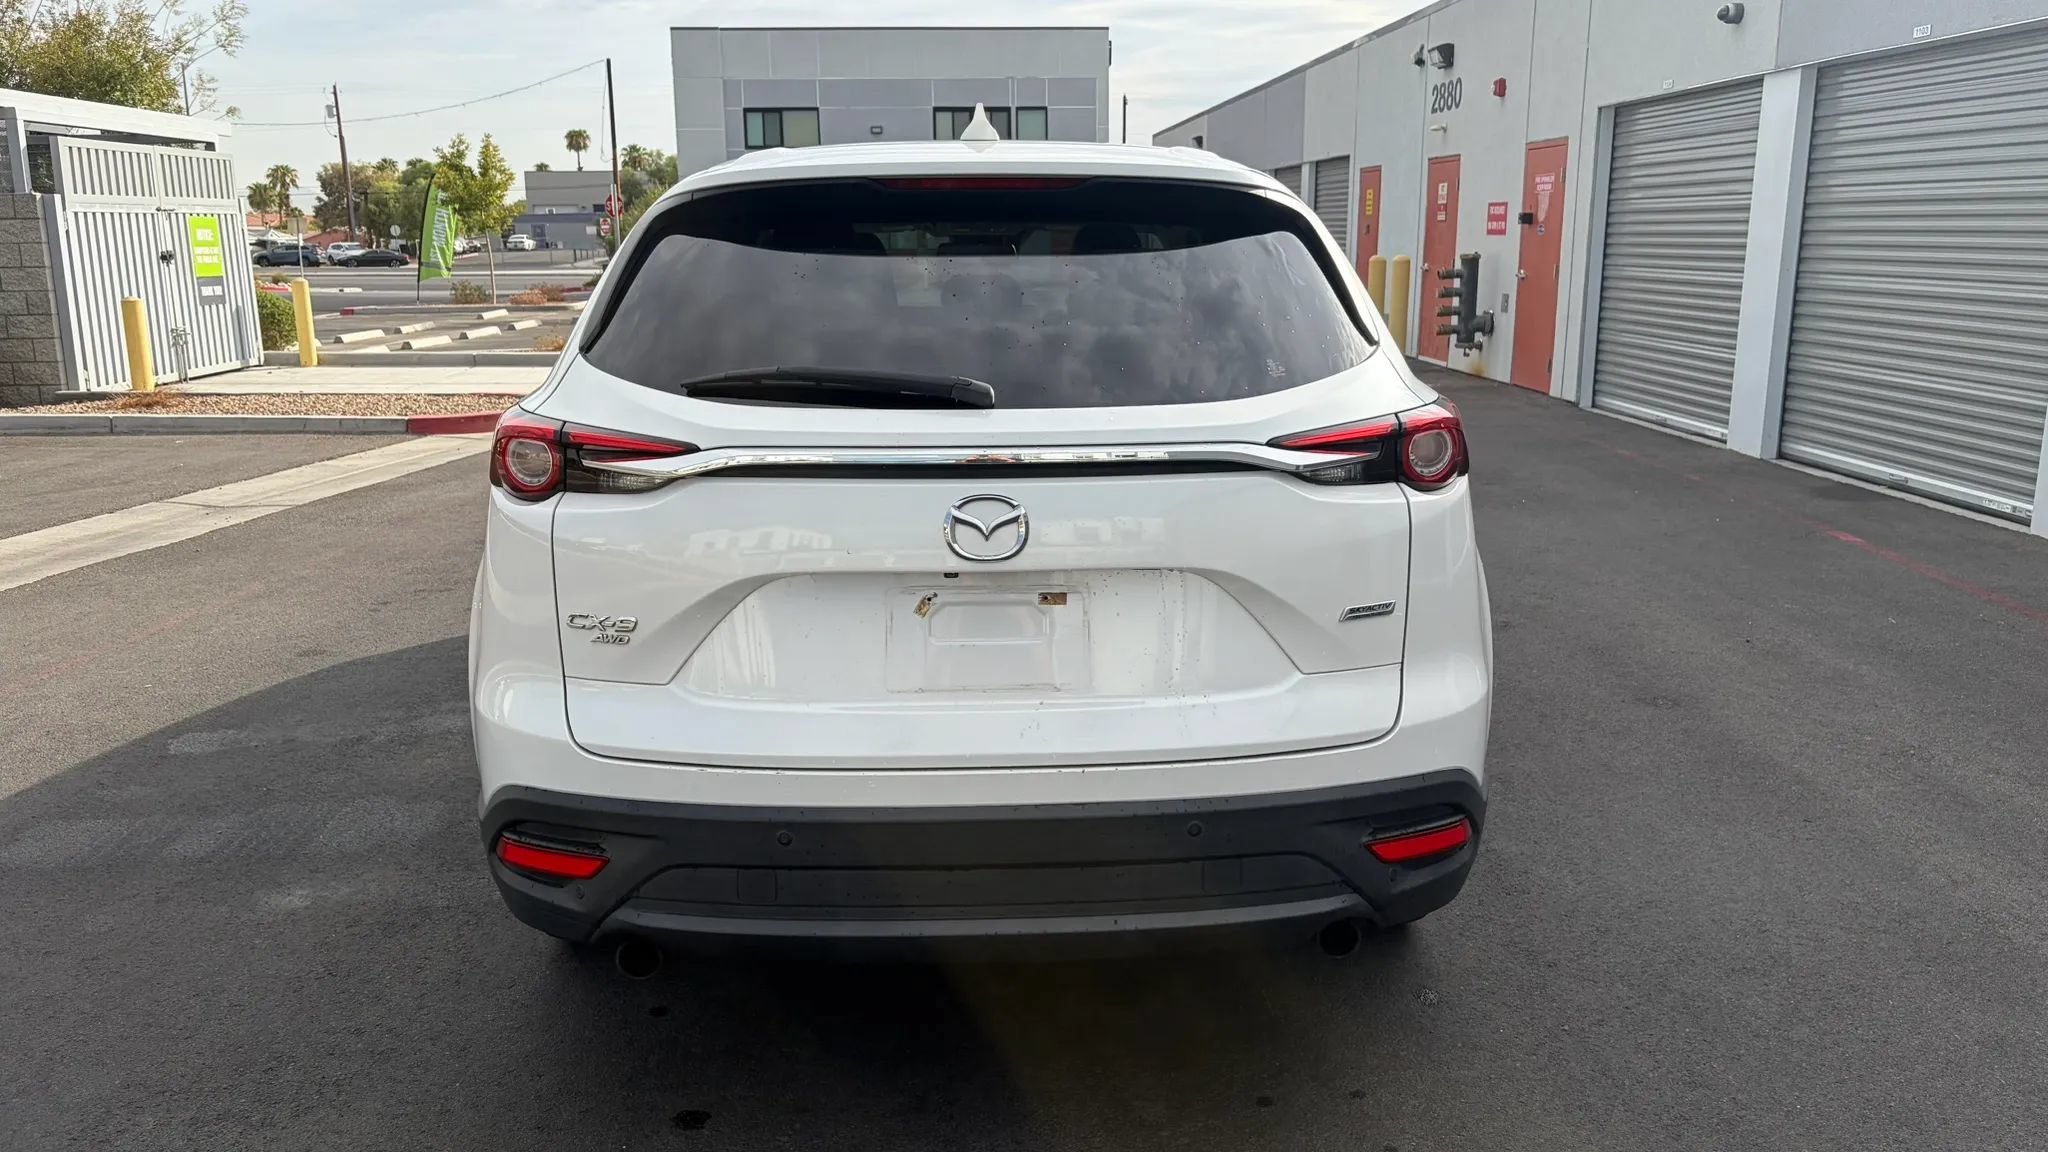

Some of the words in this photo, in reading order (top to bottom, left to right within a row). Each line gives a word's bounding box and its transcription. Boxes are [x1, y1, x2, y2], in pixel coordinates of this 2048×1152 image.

[1431, 77, 1462, 114] 2880
[606, 201, 623, 210] SP
[1348, 602, 1393, 615] SKYACTIV
[566, 614, 638, 632] CX-9
[590, 633, 631, 645] AWD
